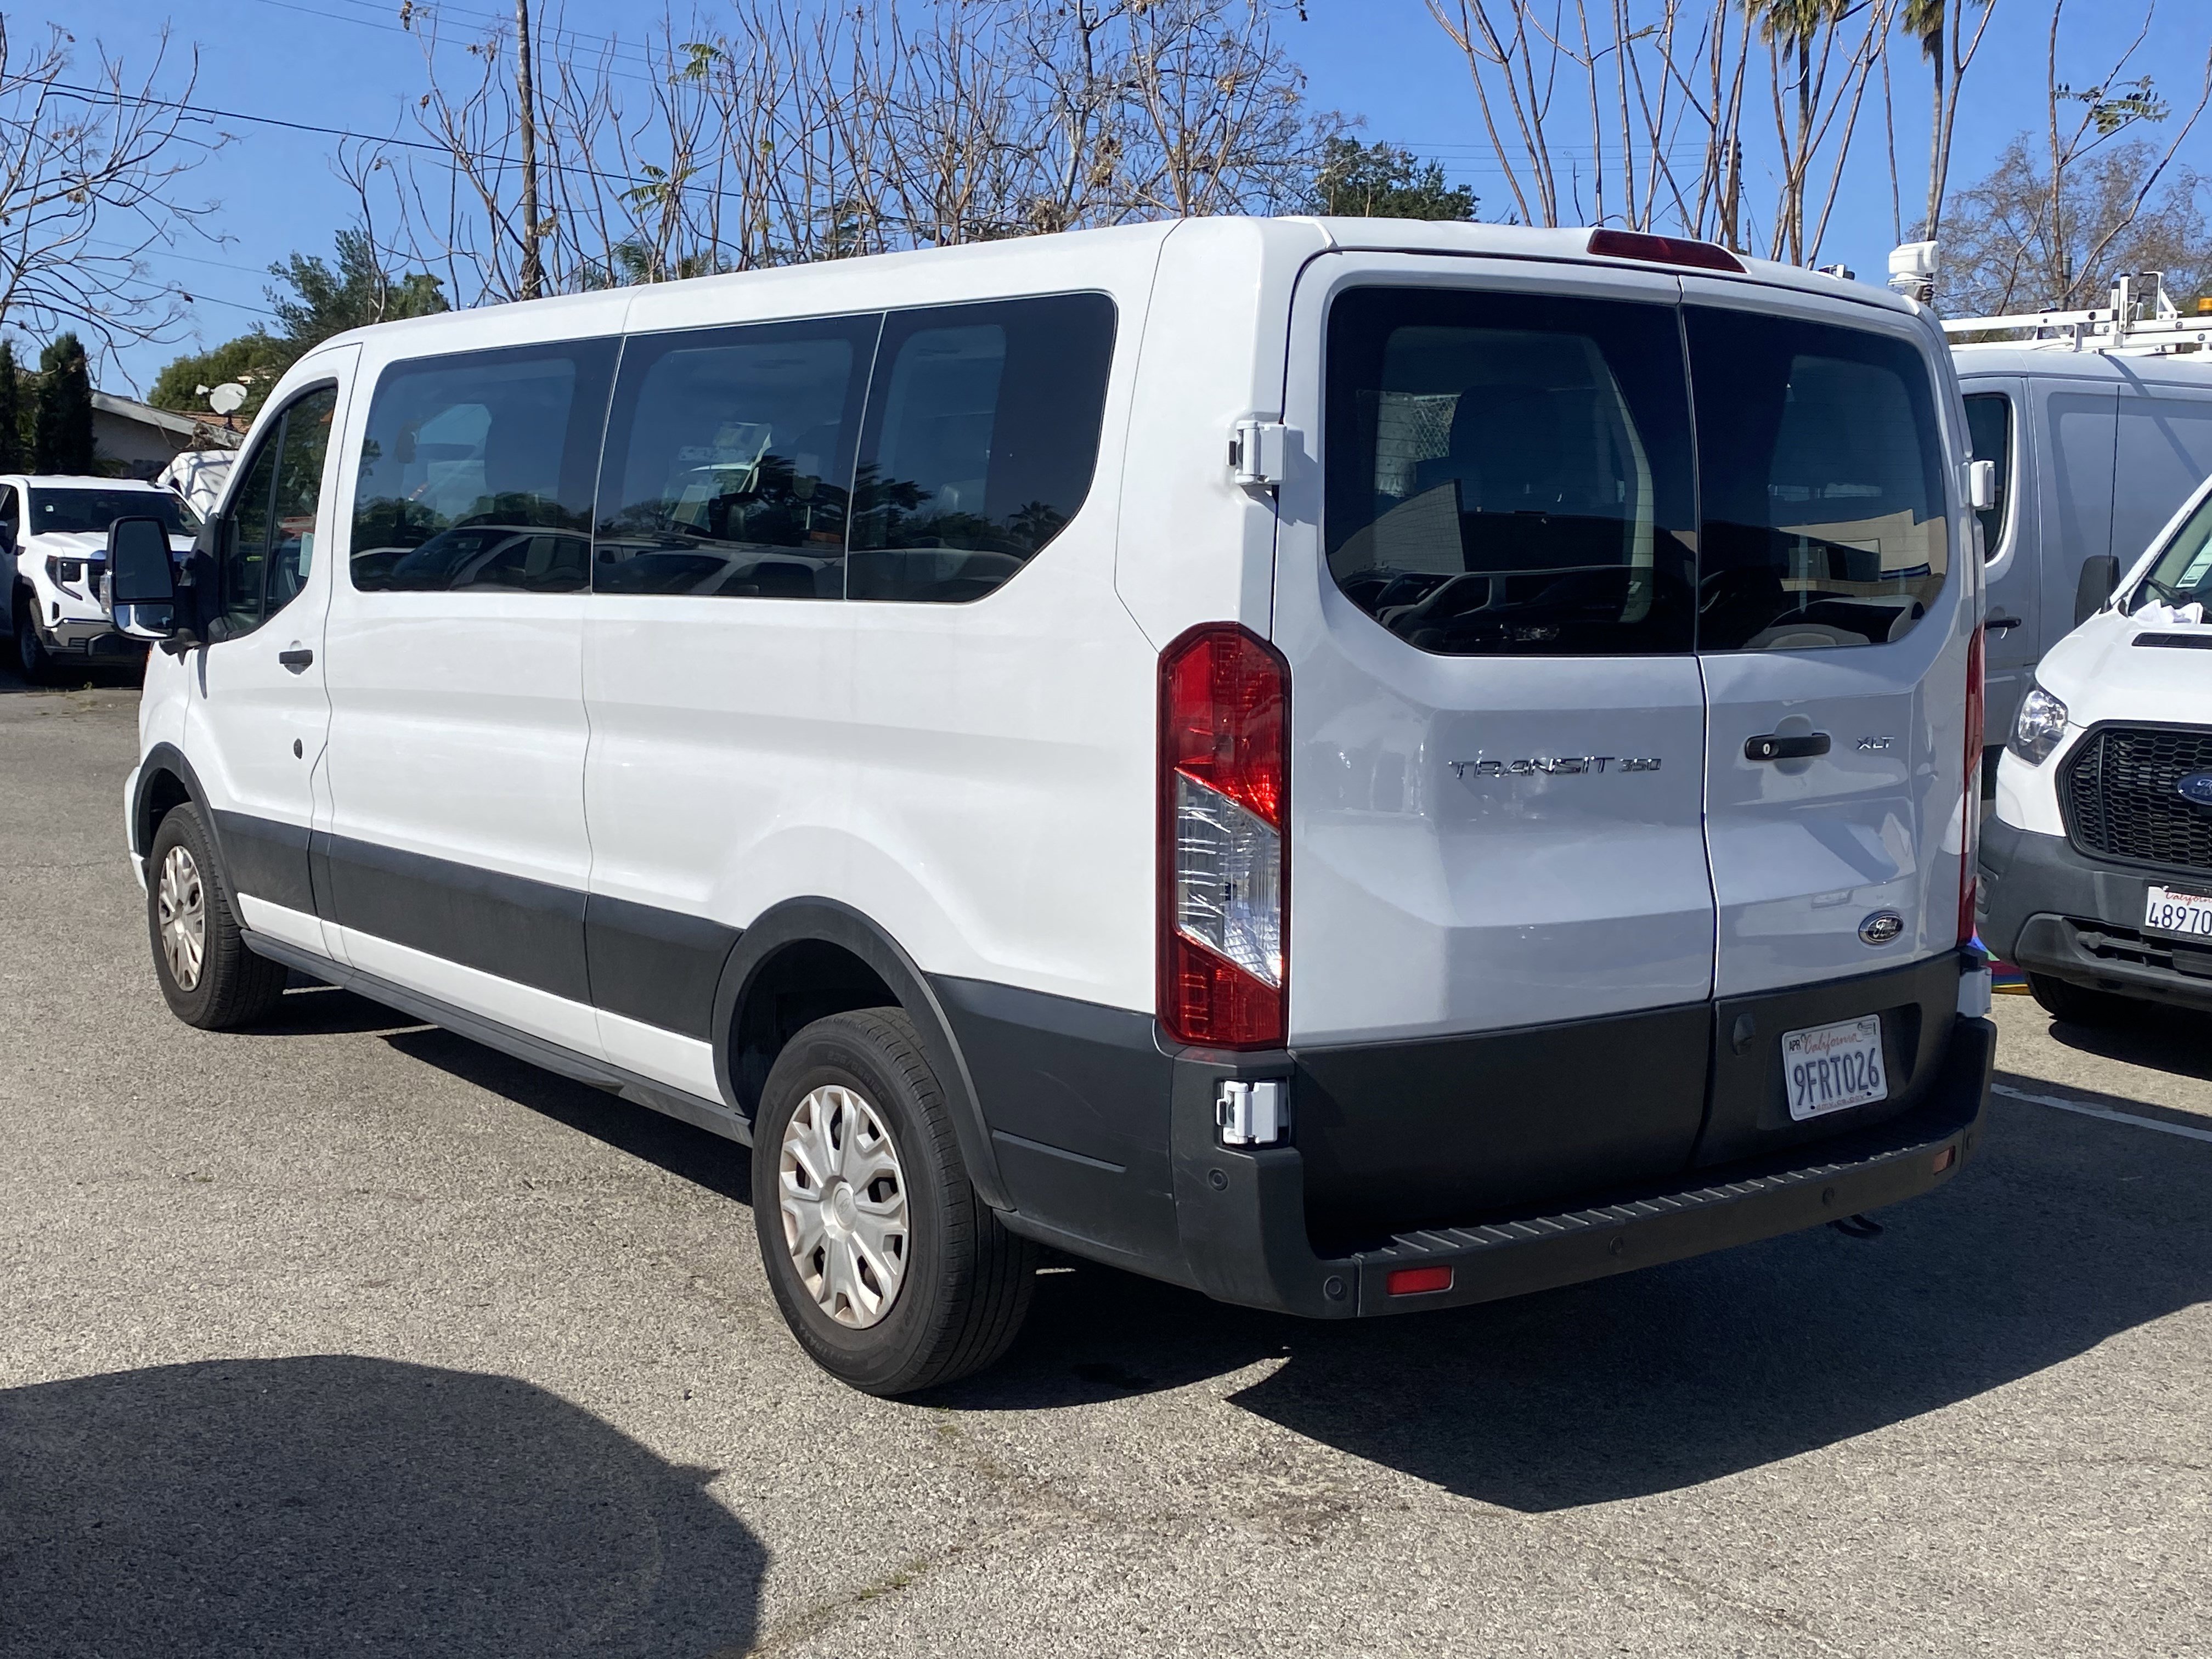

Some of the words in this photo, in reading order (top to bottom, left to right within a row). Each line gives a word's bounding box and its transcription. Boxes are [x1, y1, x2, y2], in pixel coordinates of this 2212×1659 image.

[1857, 736, 1895, 750] XLT
[1448, 755, 1615, 780] TRANSIT
[1618, 758, 1662, 772] 350
[1804, 1031, 1864, 1056] California
[1793, 1047, 1880, 1106] 9FRT026
